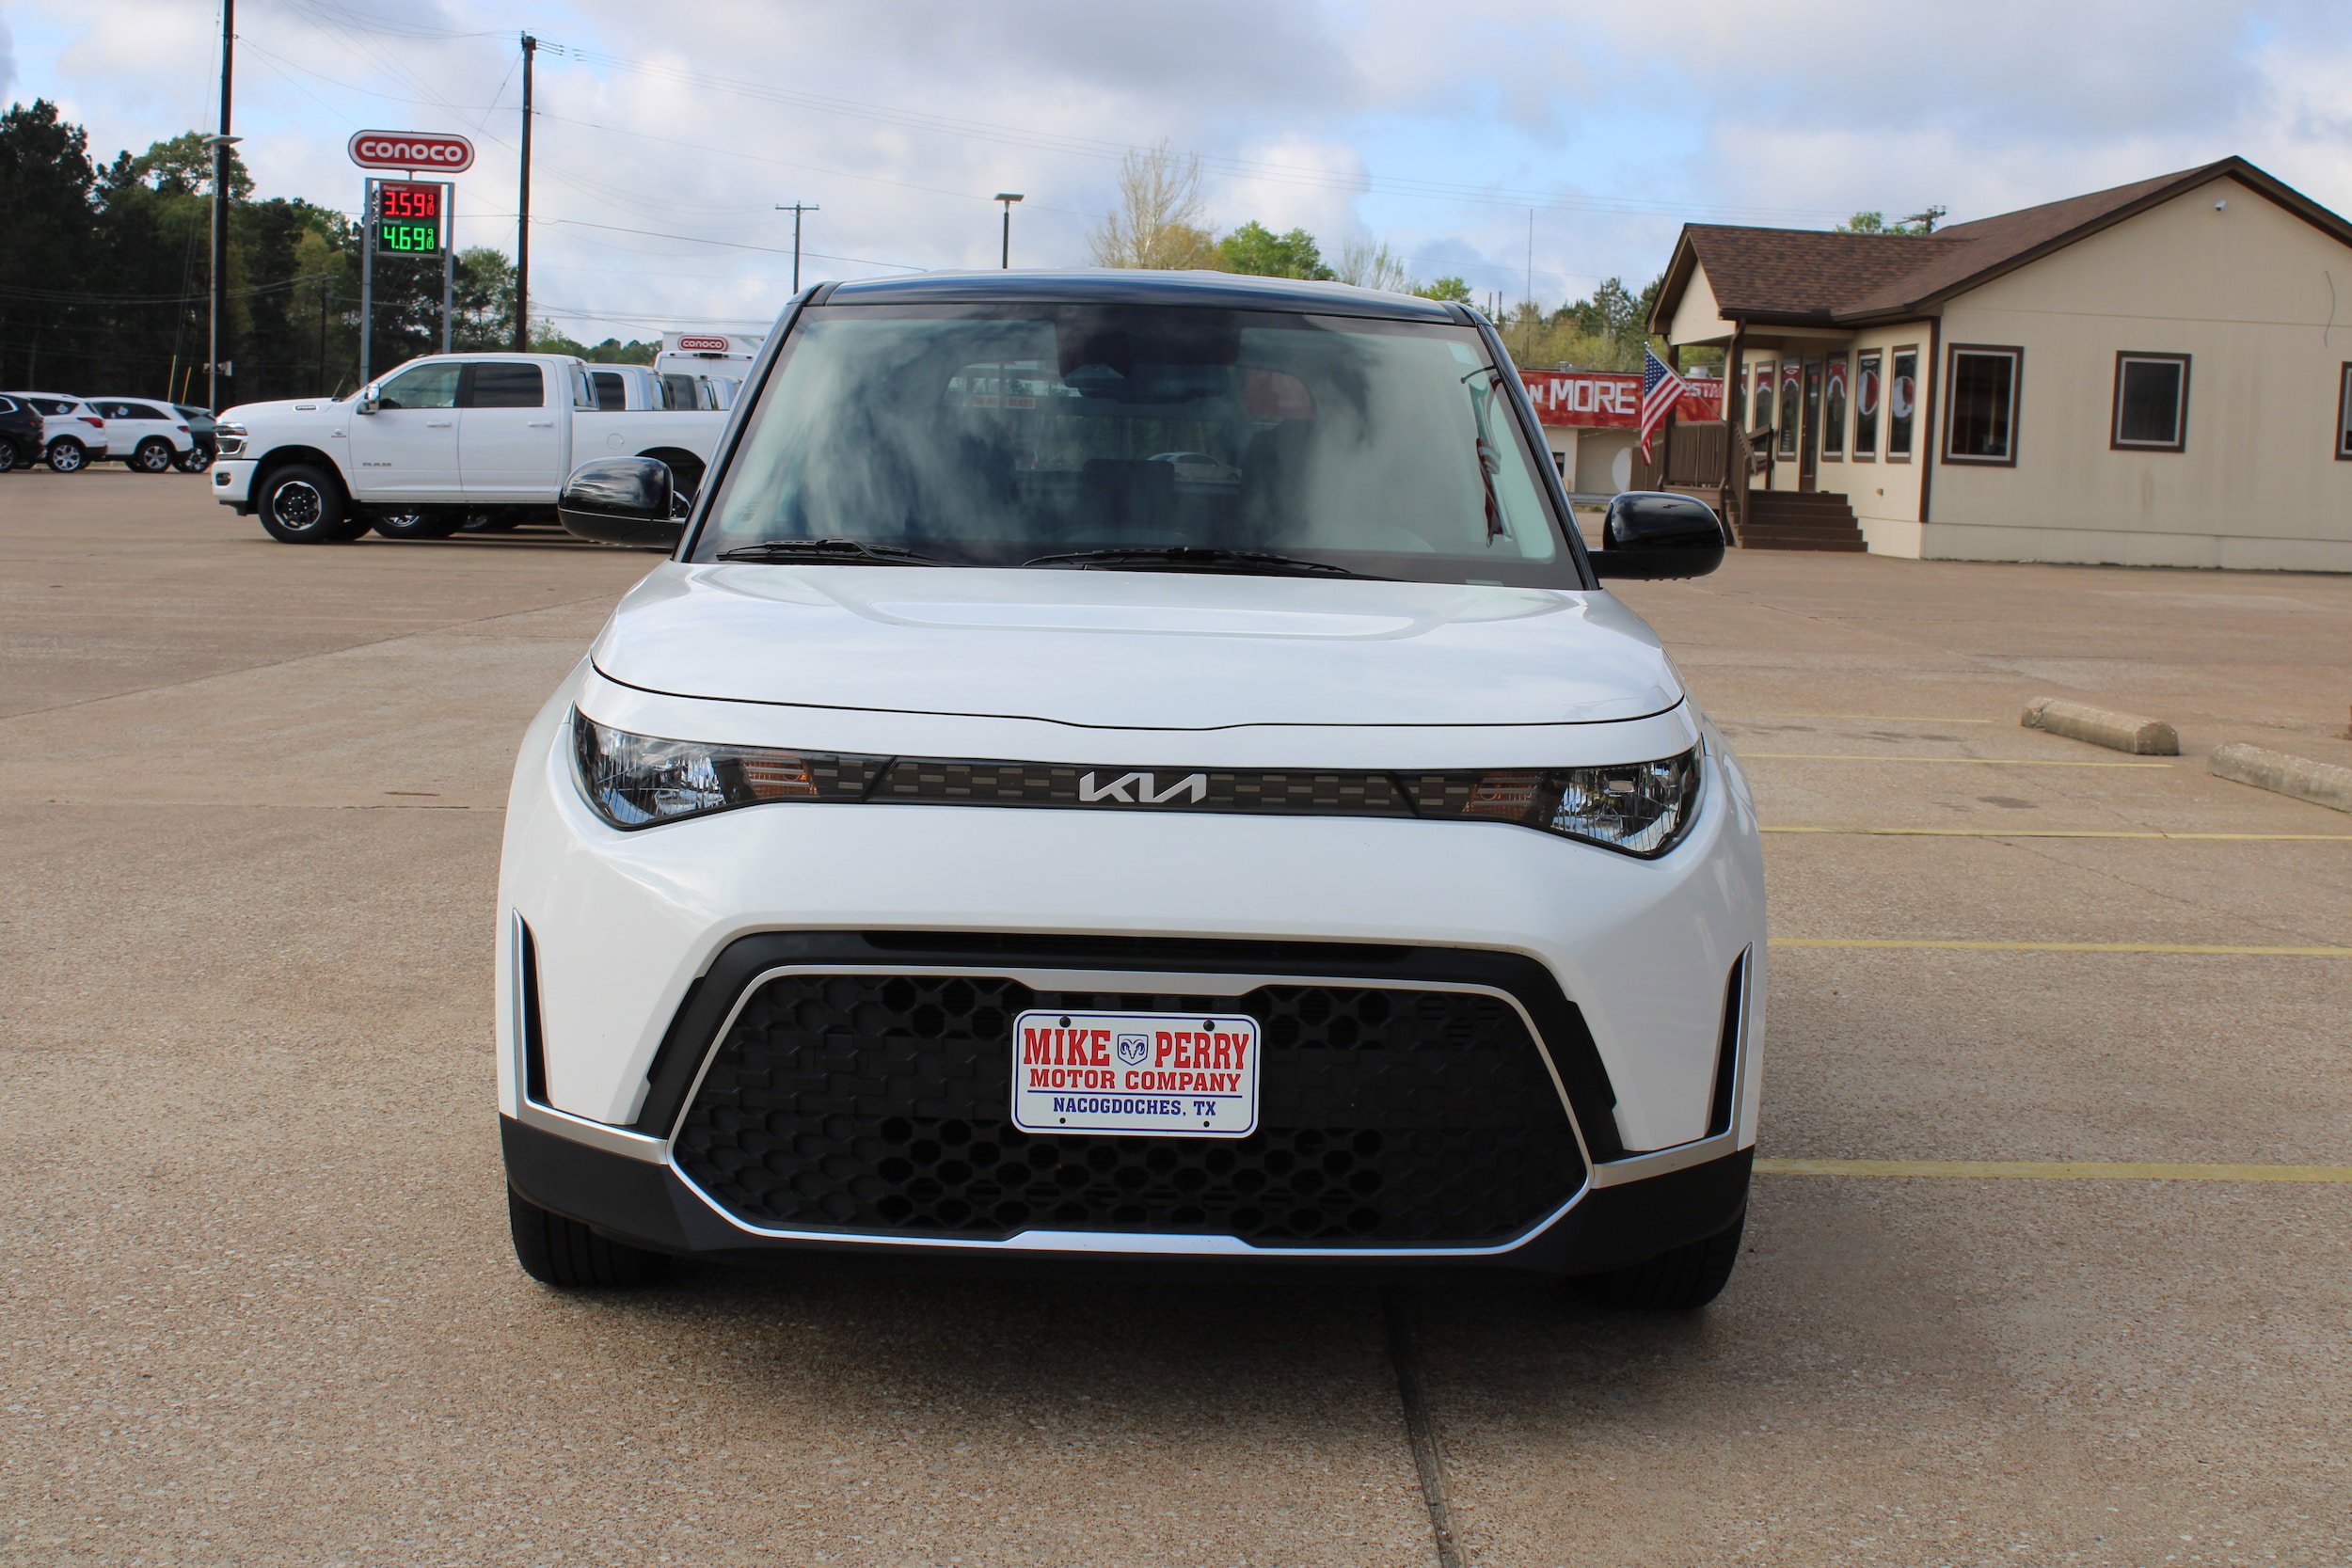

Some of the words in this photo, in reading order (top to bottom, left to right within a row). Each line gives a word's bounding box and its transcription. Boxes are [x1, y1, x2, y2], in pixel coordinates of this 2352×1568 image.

[1549, 378, 1637, 415] MORE
[1079, 771, 1206, 803] KIA
[1024, 1028, 1111, 1067] MIKE
[1154, 1031, 1249, 1069] PERRY
[1029, 1069, 1116, 1089] MOTOR
[1125, 1070, 1241, 1092] COMPANY
[1053, 1097, 1187, 1117] NACOGDOCHES,
[1193, 1101, 1216, 1116] TX
